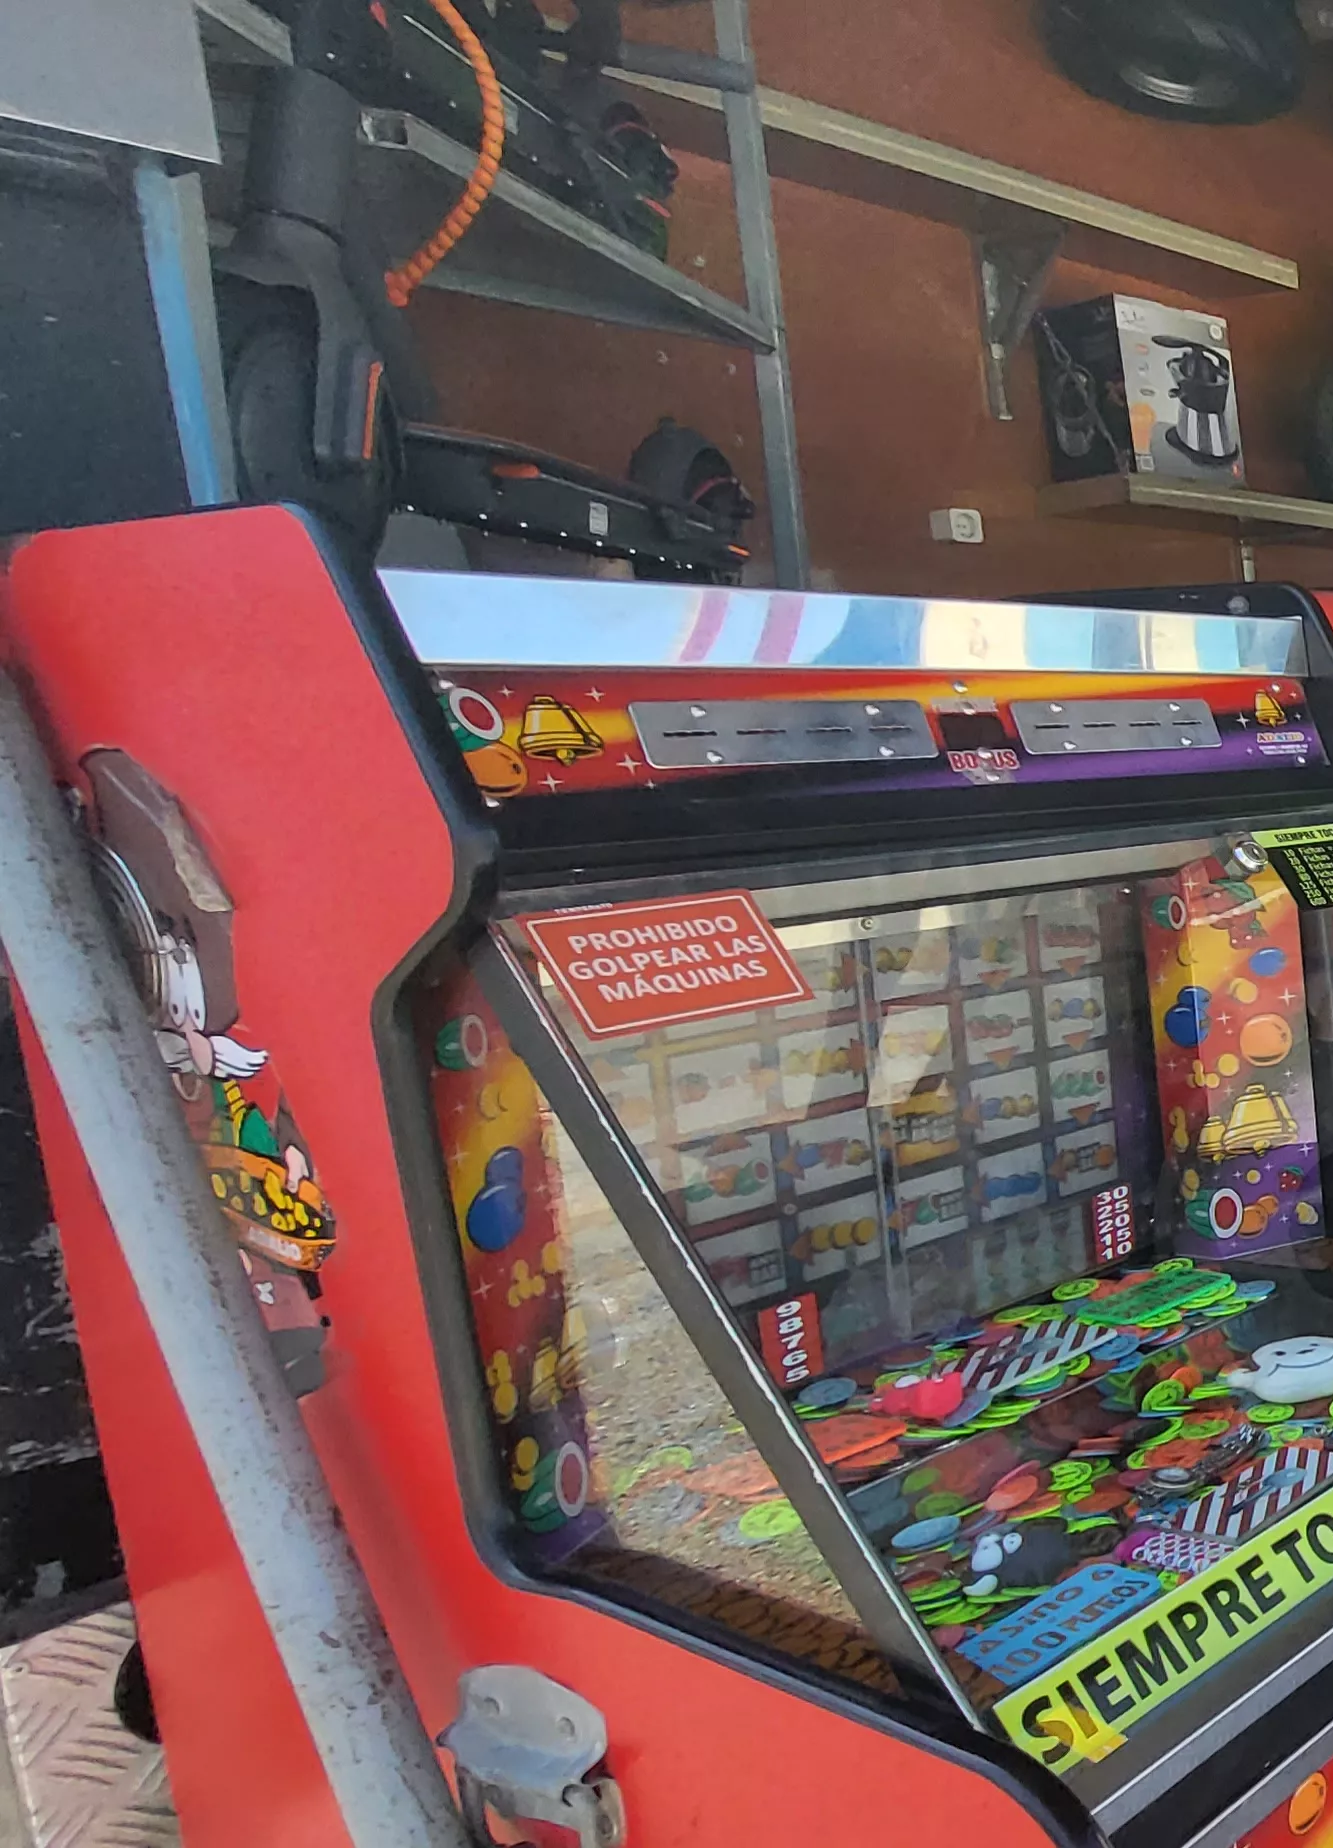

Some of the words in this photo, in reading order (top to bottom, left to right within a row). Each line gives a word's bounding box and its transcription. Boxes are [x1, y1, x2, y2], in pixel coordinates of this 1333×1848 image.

[1274, 831, 1318, 842] SIEMPRE
[567, 915, 738, 955] PROHIBIDO
[567, 943, 713, 981] GOLPEAR
[714, 934, 768, 958] LAS
[597, 959, 768, 1004] MÁQUINAS
[1096, 1185, 1128, 1205] 30
[1097, 1199, 1129, 1217] 25
[1098, 1214, 1130, 1234] 20
[1100, 1228, 1132, 1246] 15
[1101, 1240, 1132, 1260] 10
[776, 1301, 802, 1317] 9
[779, 1316, 804, 1334] 8
[781, 1332, 805, 1350] 7
[782, 1350, 808, 1366] 6
[786, 1365, 810, 1383] 5
[978, 1586, 1084, 1655] ASINO
[988, 1631, 1067, 1678] 100
[1021, 1555, 1287, 1765] SIEMPRE
